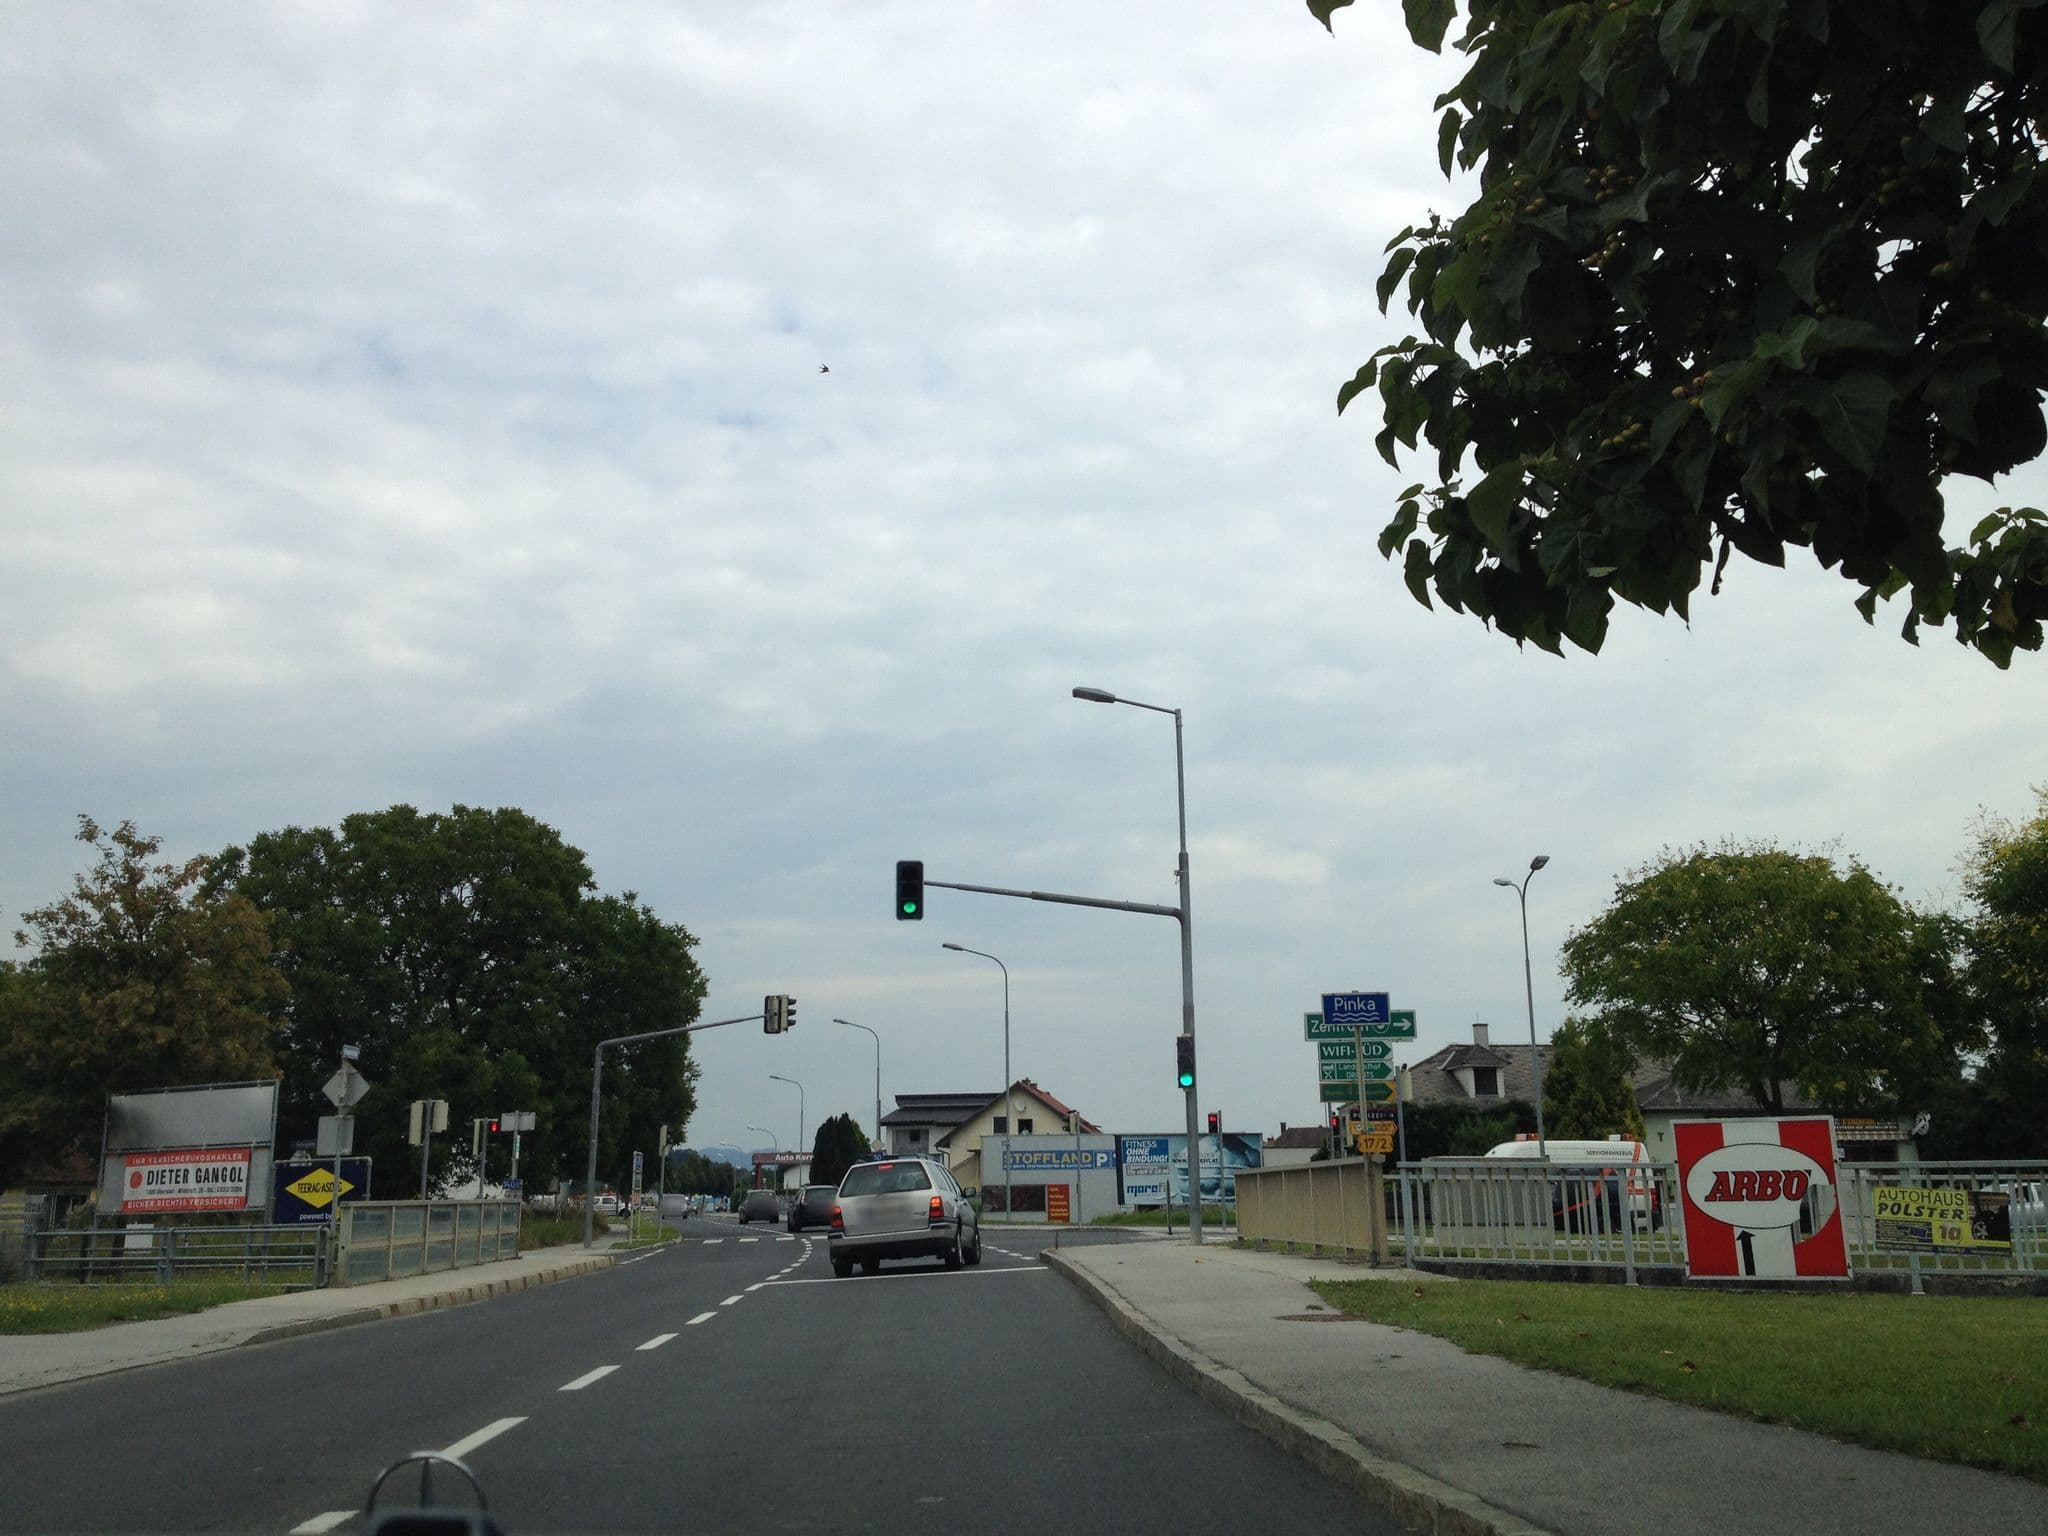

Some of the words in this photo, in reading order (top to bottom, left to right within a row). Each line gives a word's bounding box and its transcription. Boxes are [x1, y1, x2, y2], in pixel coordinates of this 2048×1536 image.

[1333, 997, 1376, 1012] Pinka
[1321, 1042, 1383, 1057] WIFI-ÜD
[1353, 1111, 1384, 1119] POIZEI
[1125, 1140, 1157, 1149] FITNESS
[775, 1153, 794, 1161] Auto
[1125, 1148, 1150, 1156] OHNE
[1126, 1155, 1168, 1163] BINDUNG!
[146, 1168, 190, 1186] DIETER
[194, 1166, 243, 1184] GANGOL
[297, 1181, 342, 1193] TEERAG-ASDG
[1878, 1189, 1965, 1207] AUTOHAUS
